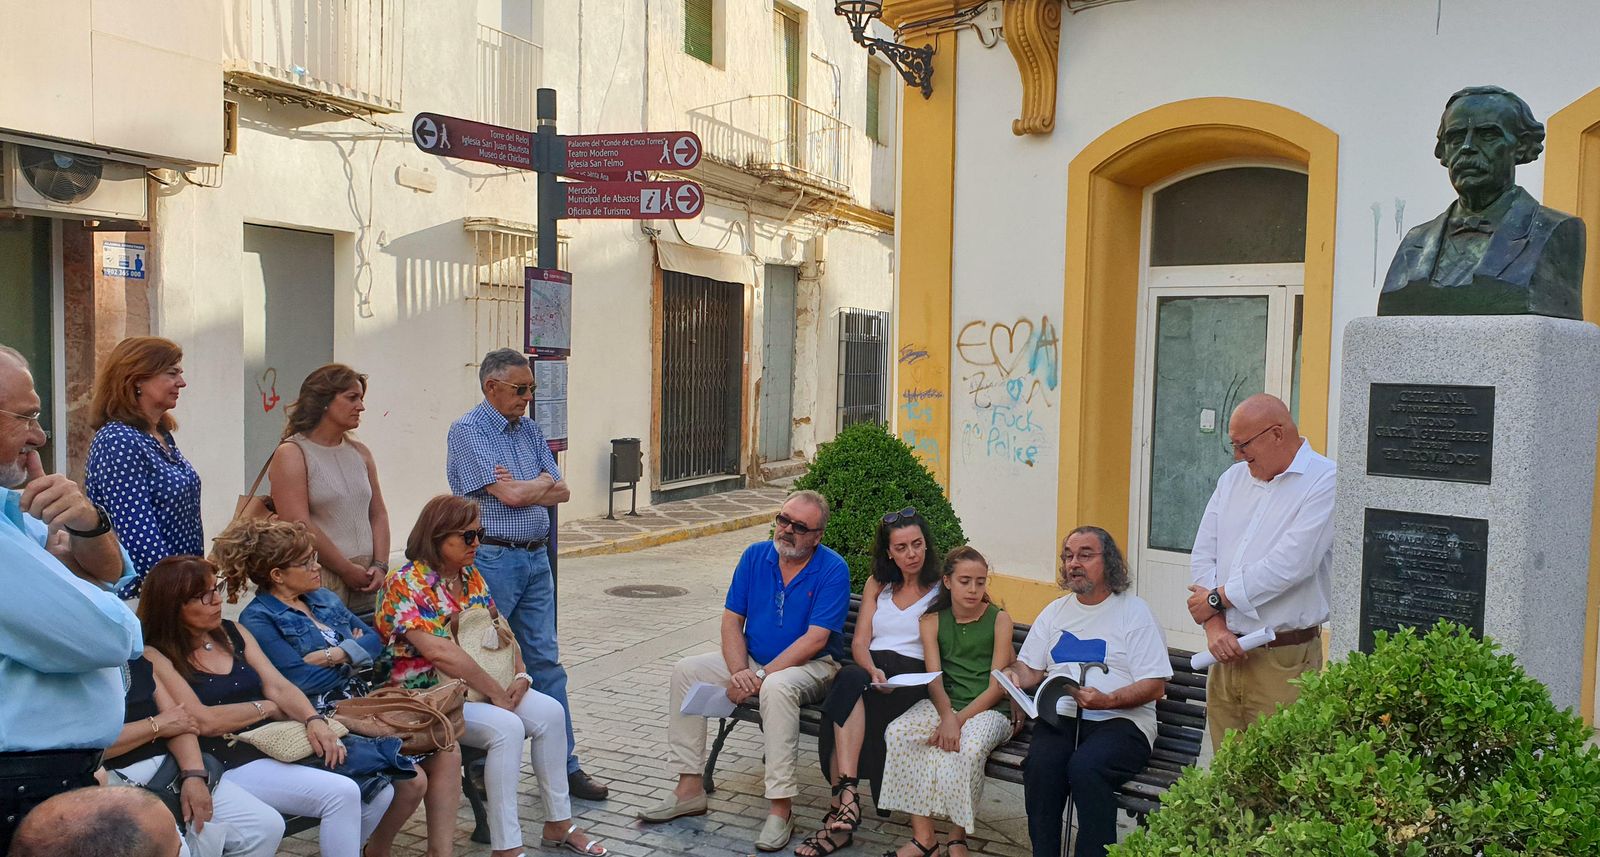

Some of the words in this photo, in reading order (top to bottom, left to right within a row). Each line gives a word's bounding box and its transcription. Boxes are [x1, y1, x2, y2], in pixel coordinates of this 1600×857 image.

[490, 130, 505, 139] Torre
[505, 133, 515, 141] del
[515, 135, 530, 145] Reloj
[622, 138, 629, 146] de
[461, 136, 481, 147] Iglesia
[482, 139, 493, 147] San
[494, 141, 507, 151] Juan
[508, 144, 530, 154] Bautista
[479, 149, 498, 159] Museo
[498, 152, 507, 160] de
[507, 154, 530, 164] Chiclana
[589, 149, 619, 157] Moderno
[567, 160, 588, 169] Iglesia
[603, 159, 624, 167] Telmo
[568, 186, 597, 194] Mercado
[568, 195, 600, 205] Municipal
[601, 195, 611, 203] de
[612, 195, 640, 203] Abastos
[568, 207, 592, 217] Oficina
[593, 207, 602, 215] de
[603, 207, 631, 215] Turismo
